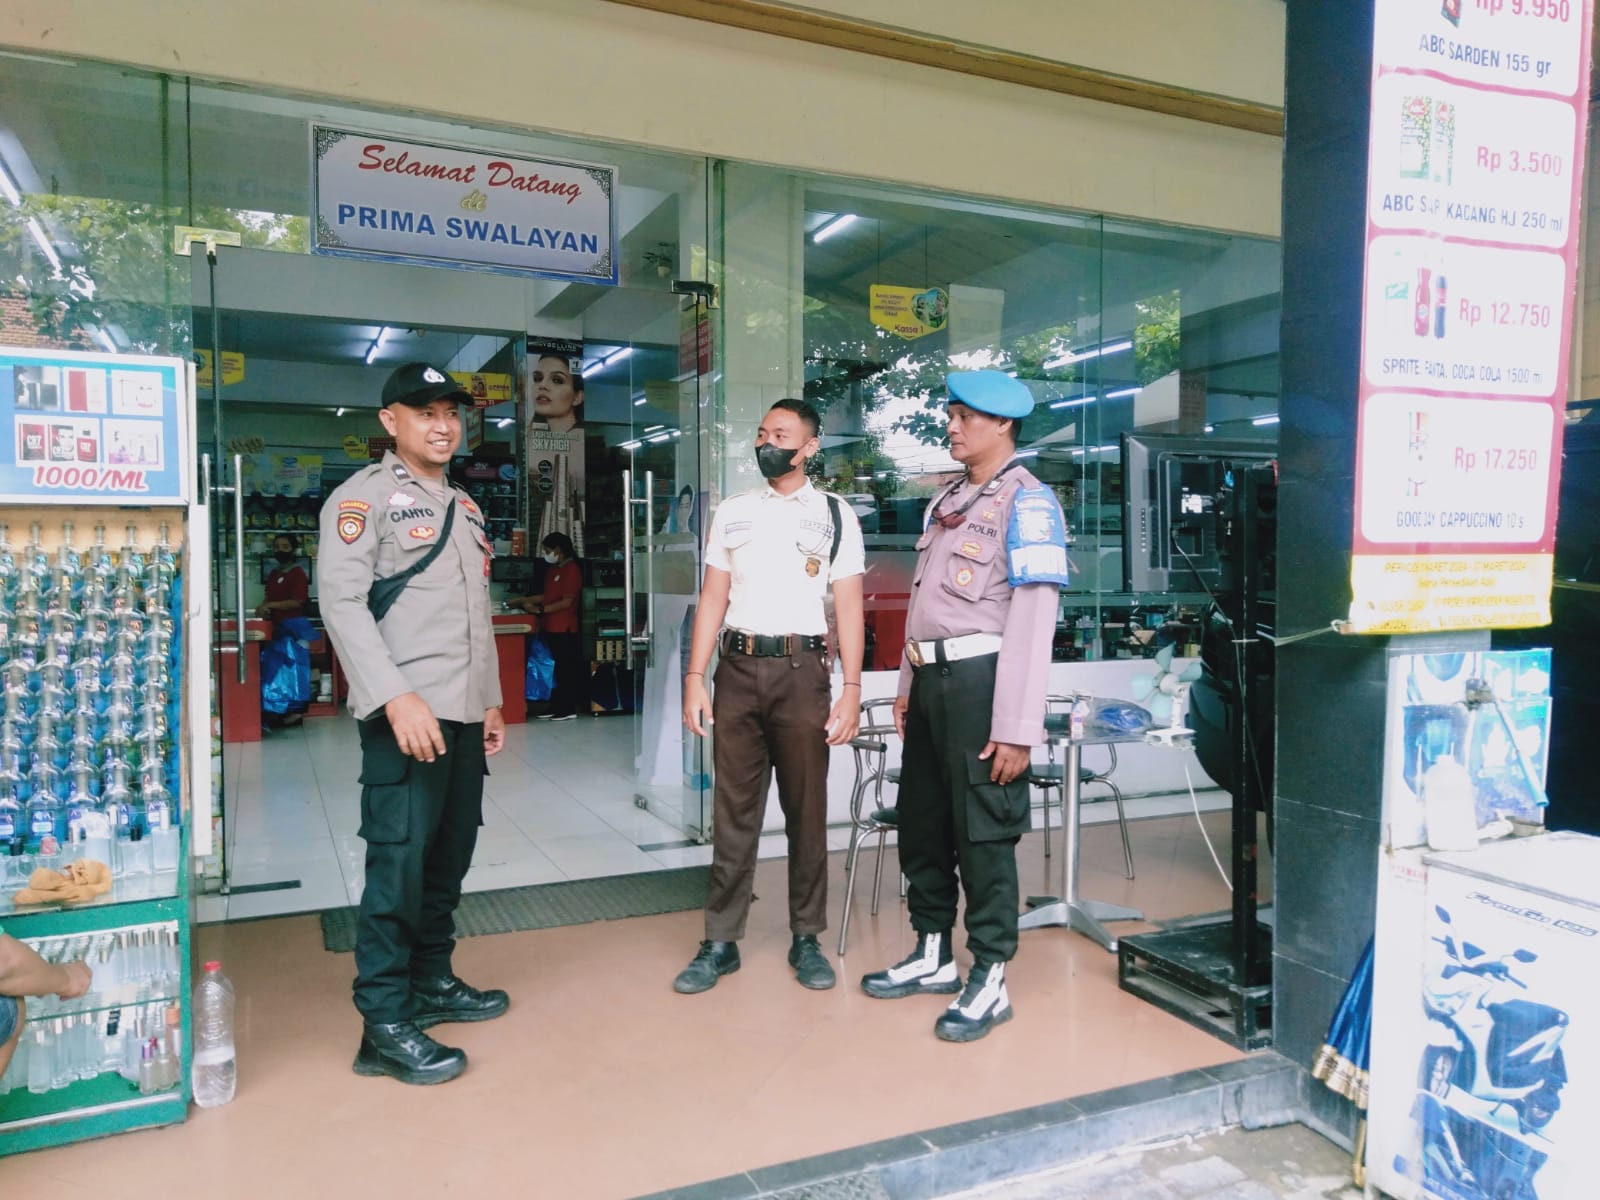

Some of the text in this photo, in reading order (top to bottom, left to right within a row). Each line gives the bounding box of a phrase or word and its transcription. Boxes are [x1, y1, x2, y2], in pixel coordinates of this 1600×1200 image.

[1419, 34, 1551, 78] ABC SARDEN 155 gr
[1477, 146, 1561, 176] Rp 3.500
[359, 145, 582, 204] Selamat Datang
[460, 189, 487, 212] di
[1382, 194, 1414, 212] ABC
[1447, 203, 1496, 224] KACANG
[1501, 210, 1516, 227] HJ
[1522, 211, 1546, 229] 250
[1550, 217, 1562, 232] ml
[338, 204, 598, 254] PRIMA SWALAYAN
[1459, 298, 1550, 328] Rp 12.750
[895, 324, 918, 334] Kassa
[1452, 363, 1475, 380] COCA
[1480, 366, 1502, 382] COLA
[1507, 368, 1530, 384] 1500
[1454, 447, 1537, 472] Rp 17.250
[36, 465, 147, 490] 1000/ML
[391, 508, 435, 523] CAHYO
[1440, 511, 1502, 528] CAPPUCCINO
[967, 523, 998, 538] POLRI
